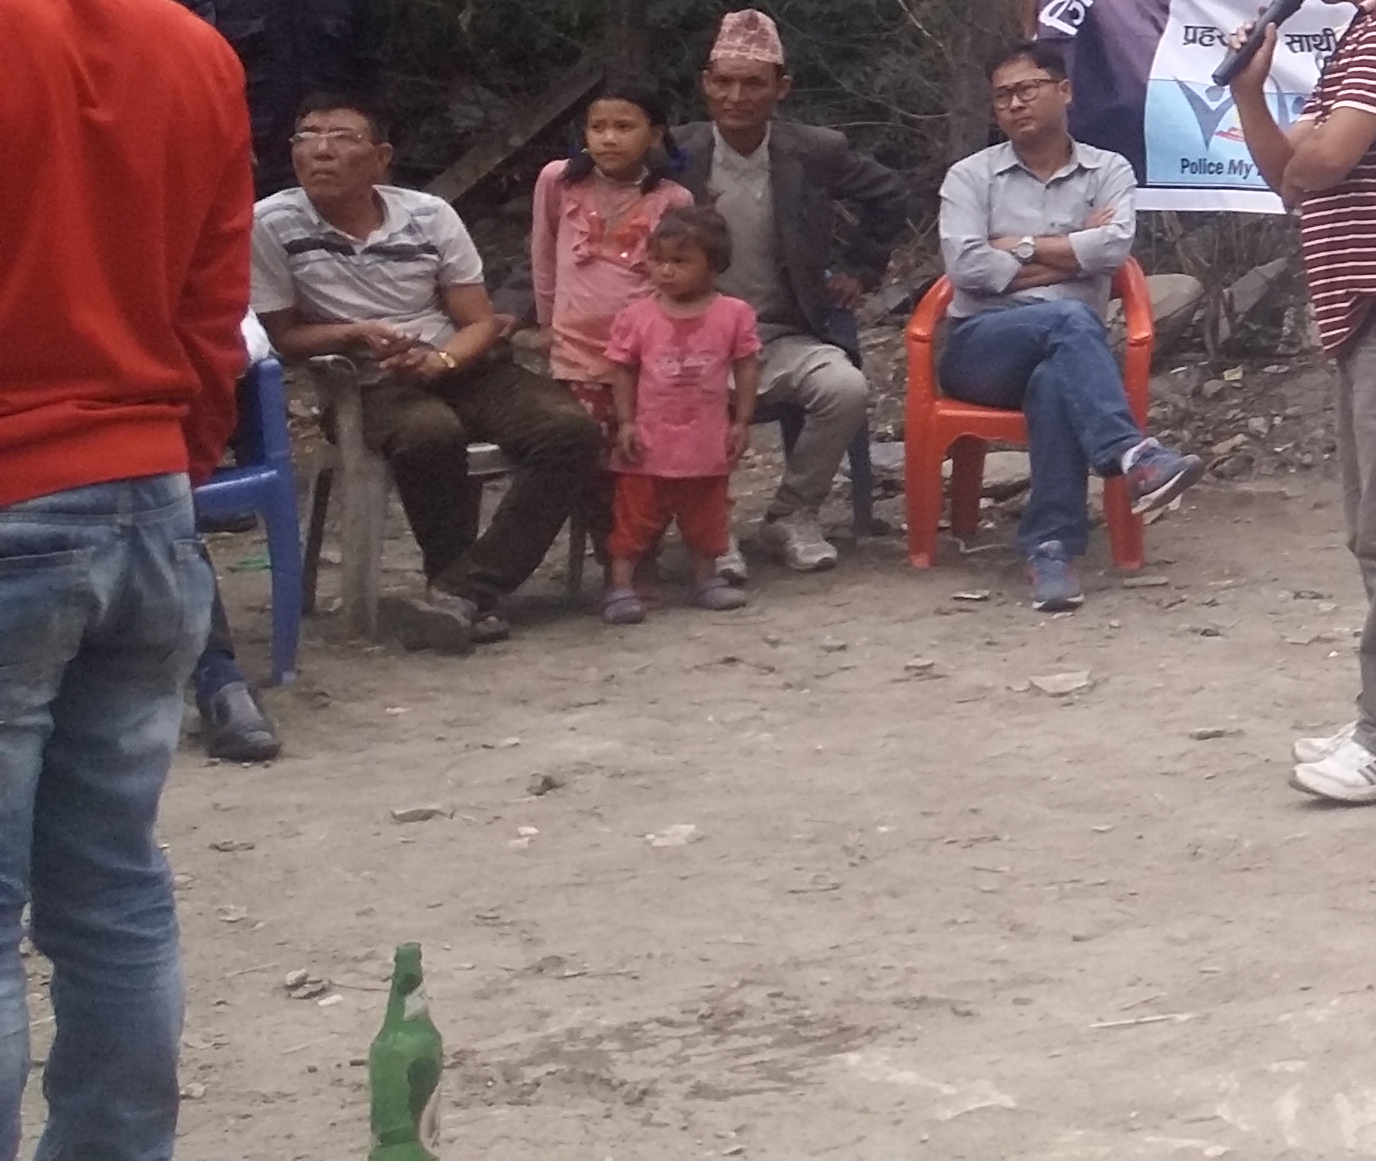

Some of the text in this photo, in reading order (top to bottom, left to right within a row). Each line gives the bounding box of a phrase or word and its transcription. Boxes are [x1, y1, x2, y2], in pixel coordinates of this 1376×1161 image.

[1285, 28, 1337, 53] साथी
[1180, 157, 1254, 179] Police My
